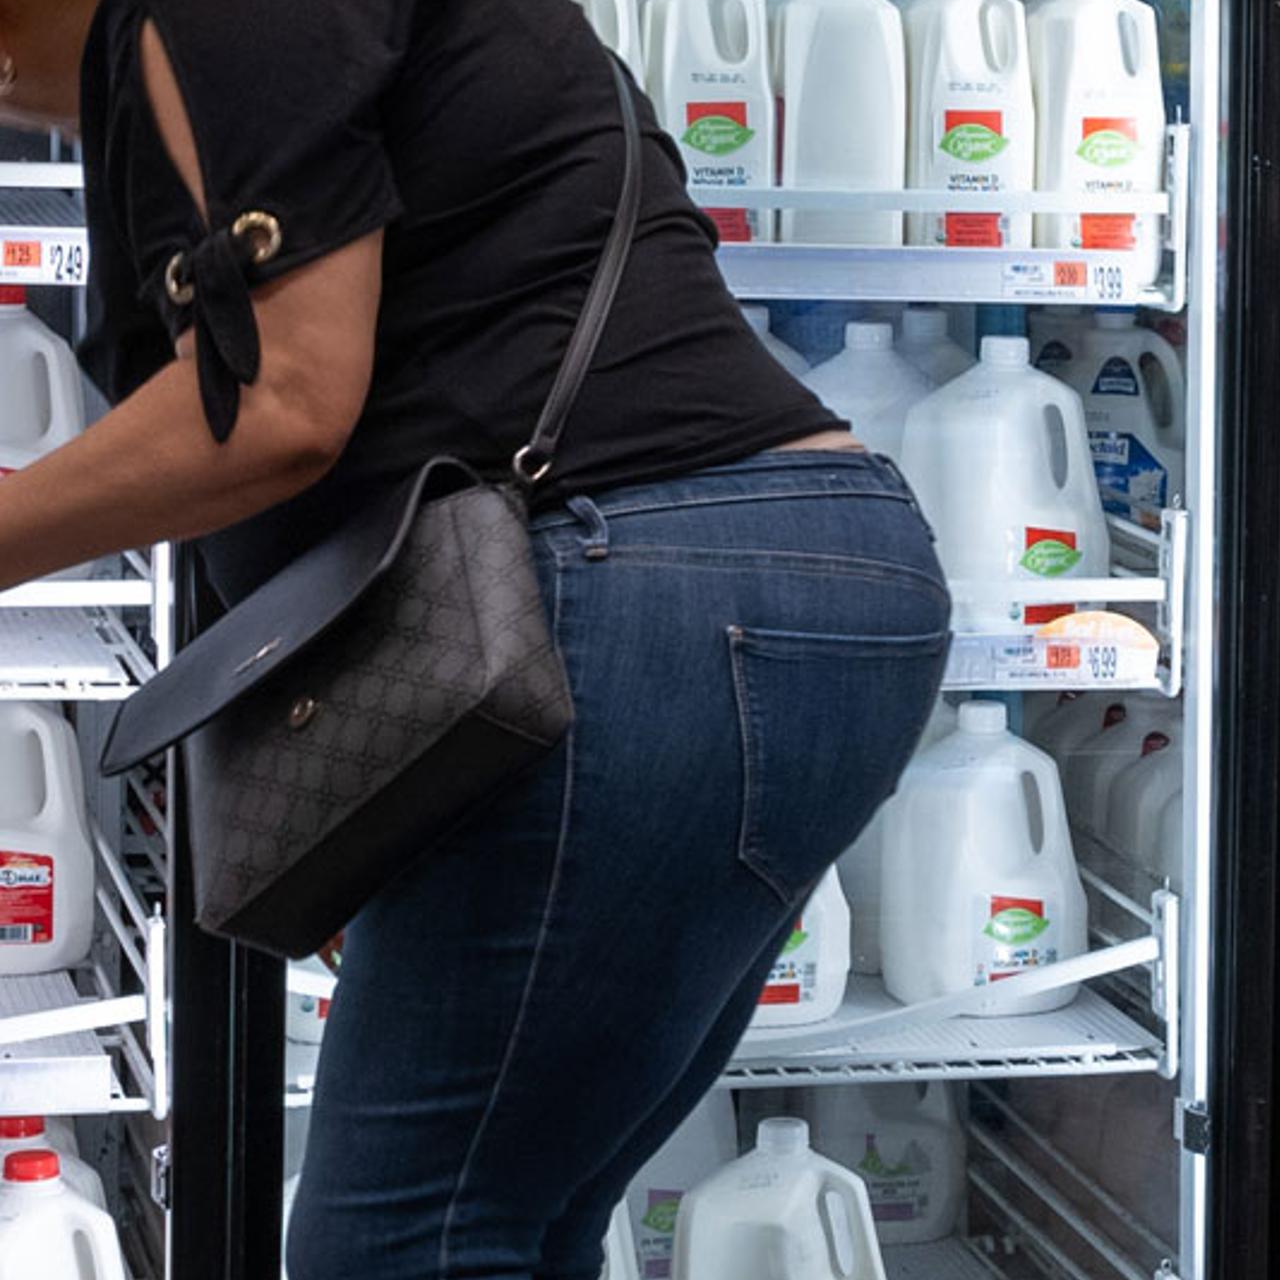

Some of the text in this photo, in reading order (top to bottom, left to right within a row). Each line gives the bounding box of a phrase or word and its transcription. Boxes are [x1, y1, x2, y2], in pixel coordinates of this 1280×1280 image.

[693, 167, 732, 177] VITAMIN
[950, 174, 988, 185] VITAMIN
[1089, 439, 1128, 457] ctaid
